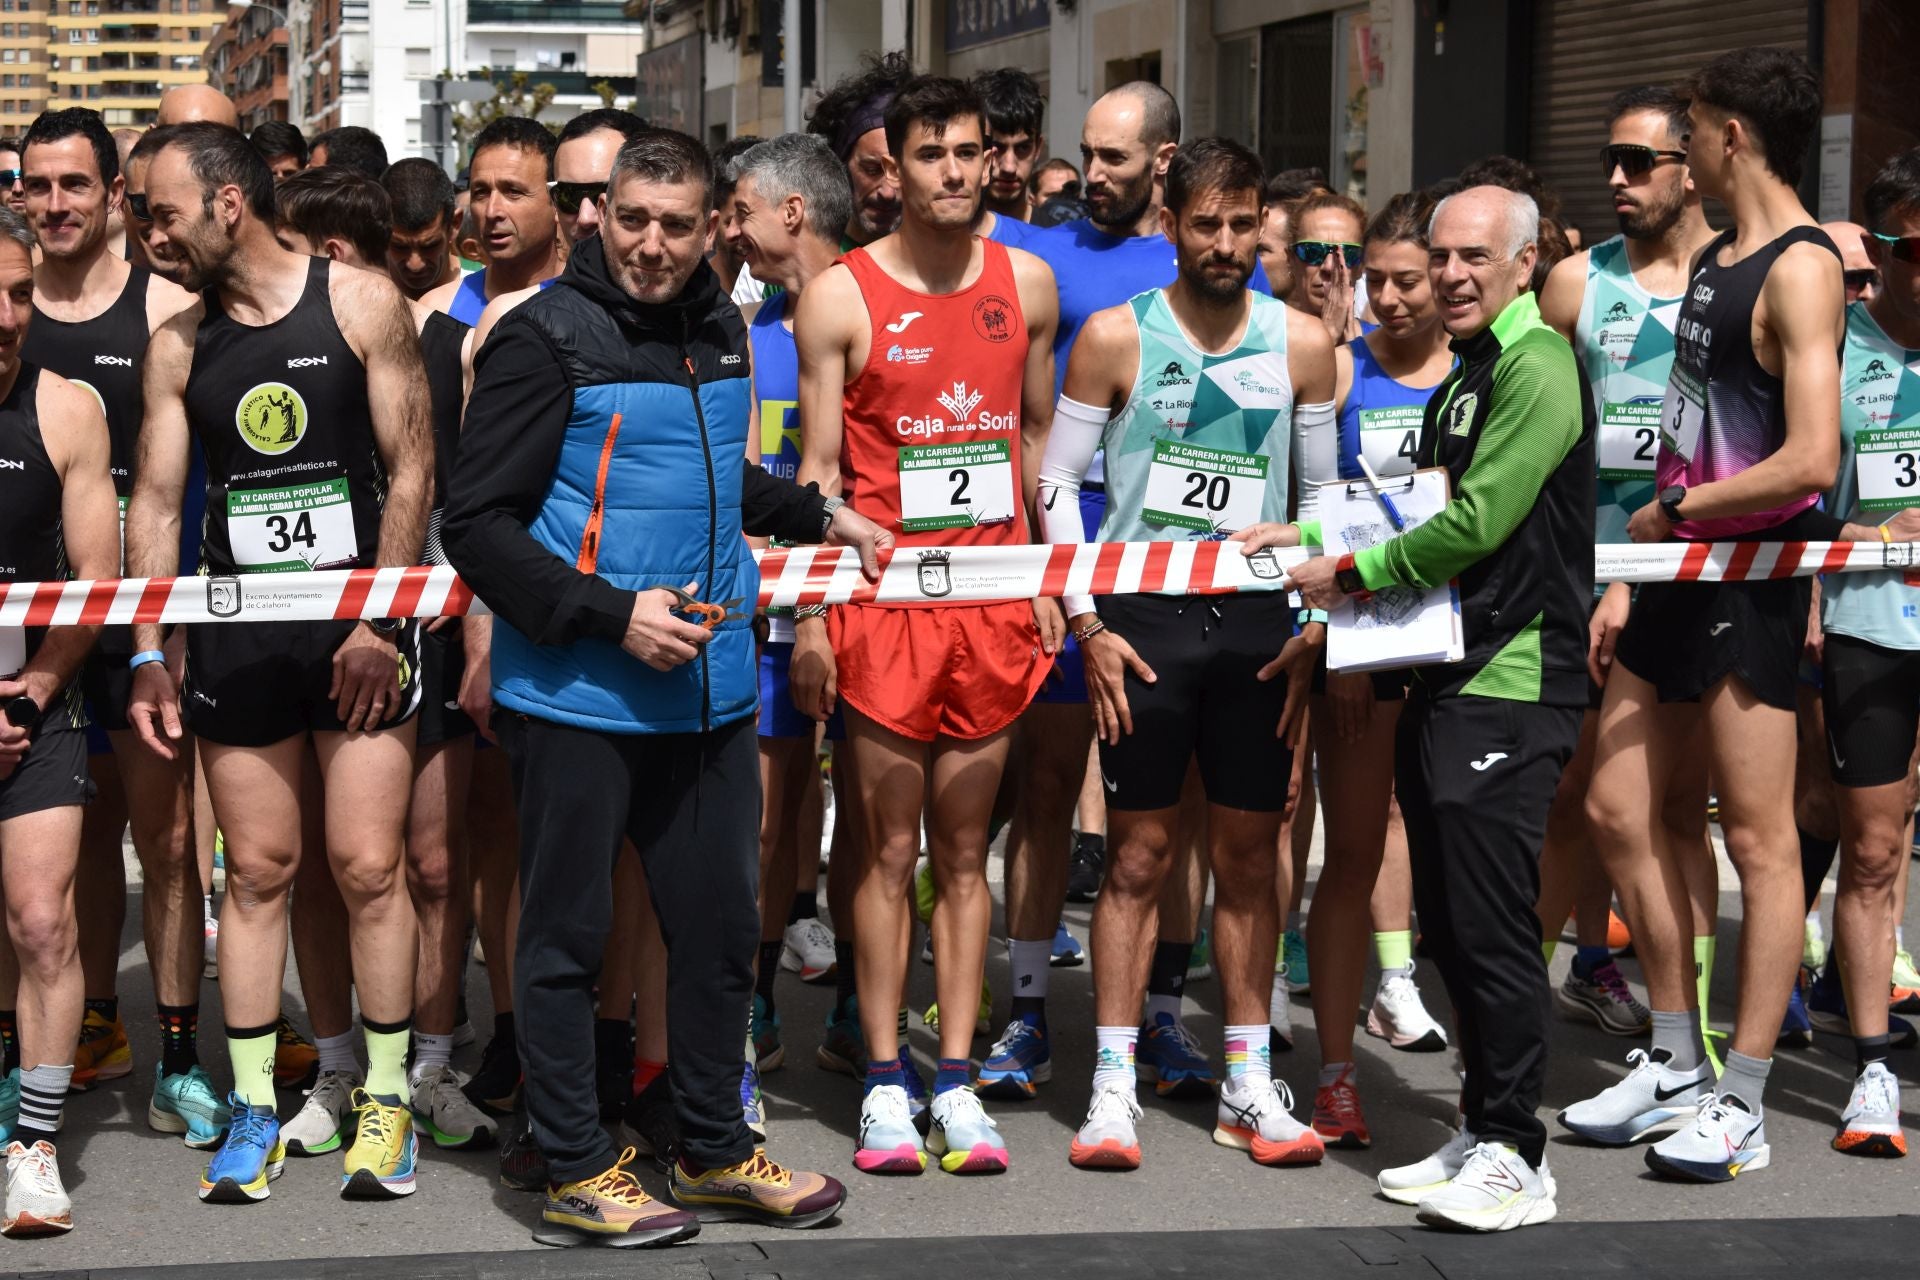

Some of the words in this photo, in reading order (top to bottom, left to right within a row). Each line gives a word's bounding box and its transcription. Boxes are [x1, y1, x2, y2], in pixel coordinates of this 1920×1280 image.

[1241, 385, 1280, 396] TRITONES
[1868, 395, 1878, 404] La
[1879, 393, 1902, 402] Rioja
[244, 395, 264, 418] ATLETICO
[1166, 401, 1175, 410] La
[1176, 400, 1198, 409] Rioja
[1374, 411, 1385, 419] XV
[1386, 409, 1423, 418] CARRERA
[1673, 395, 1685, 431] 3
[896, 415, 945, 438] Caja
[947, 424, 964, 432] rural
[966, 423, 977, 431] de
[1870, 433, 1881, 441] XV
[1882, 431, 1920, 440] CARRERA
[913, 450, 924, 458] XV
[926, 446, 963, 457] CARRERA
[965, 443, 997, 454] POPULAR
[1398, 430, 1421, 463] 4
[1634, 428, 1661, 461] 2
[903, 458, 941, 469] CALAHORRA
[942, 456, 965, 466] CIUDAD
[965, 455, 973, 464] DE
[973, 454, 981, 463] LA
[1157, 453, 1194, 466] CALAHORRA
[1195, 460, 1218, 470] CIUDAD
[1219, 464, 1227, 472] DE
[1228, 465, 1236, 473] LA
[1237, 466, 1263, 477] VERDURA
[1169, 445, 1181, 453] XV
[1182, 448, 1219, 460] CARRERA
[1220, 454, 1255, 466] POPULAR
[240, 494, 251, 503] XV
[252, 491, 290, 502] CARRERA
[293, 485, 333, 498] POPULAR
[948, 468, 972, 505] 2
[1181, 472, 1231, 512] 20
[231, 504, 269, 514] CALAHORRA
[269, 501, 294, 511] CIUDAD
[294, 500, 303, 508] DE
[304, 498, 314, 507] LA
[315, 492, 345, 504] VERDURA
[266, 511, 317, 553] 34
[273, 592, 323, 600] Ayuntamiento
[566, 1195, 600, 1216] ATOM
